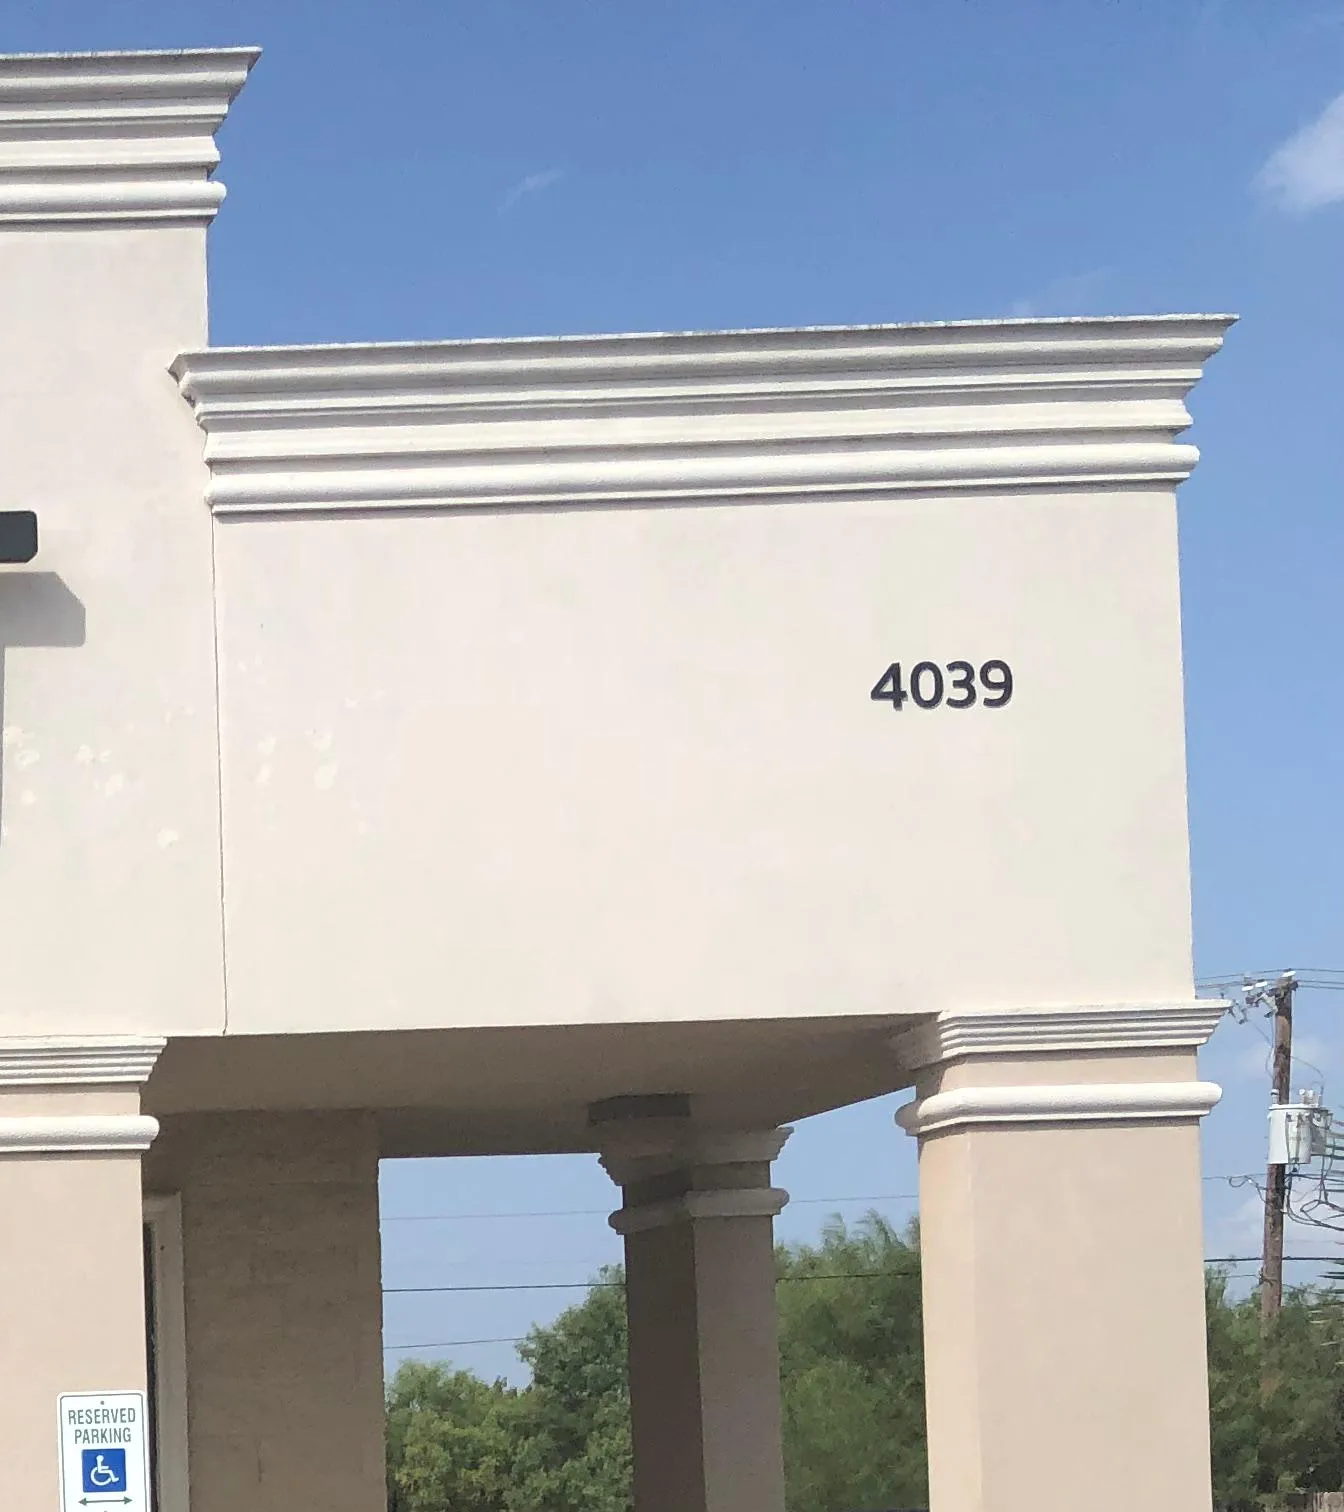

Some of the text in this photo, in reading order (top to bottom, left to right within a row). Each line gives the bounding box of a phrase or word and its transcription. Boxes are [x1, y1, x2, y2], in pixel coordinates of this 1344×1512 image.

[870, 659, 1013, 711] 4039
[68, 1407, 136, 1425] RESERVED
[74, 1427, 131, 1444] PARKING
